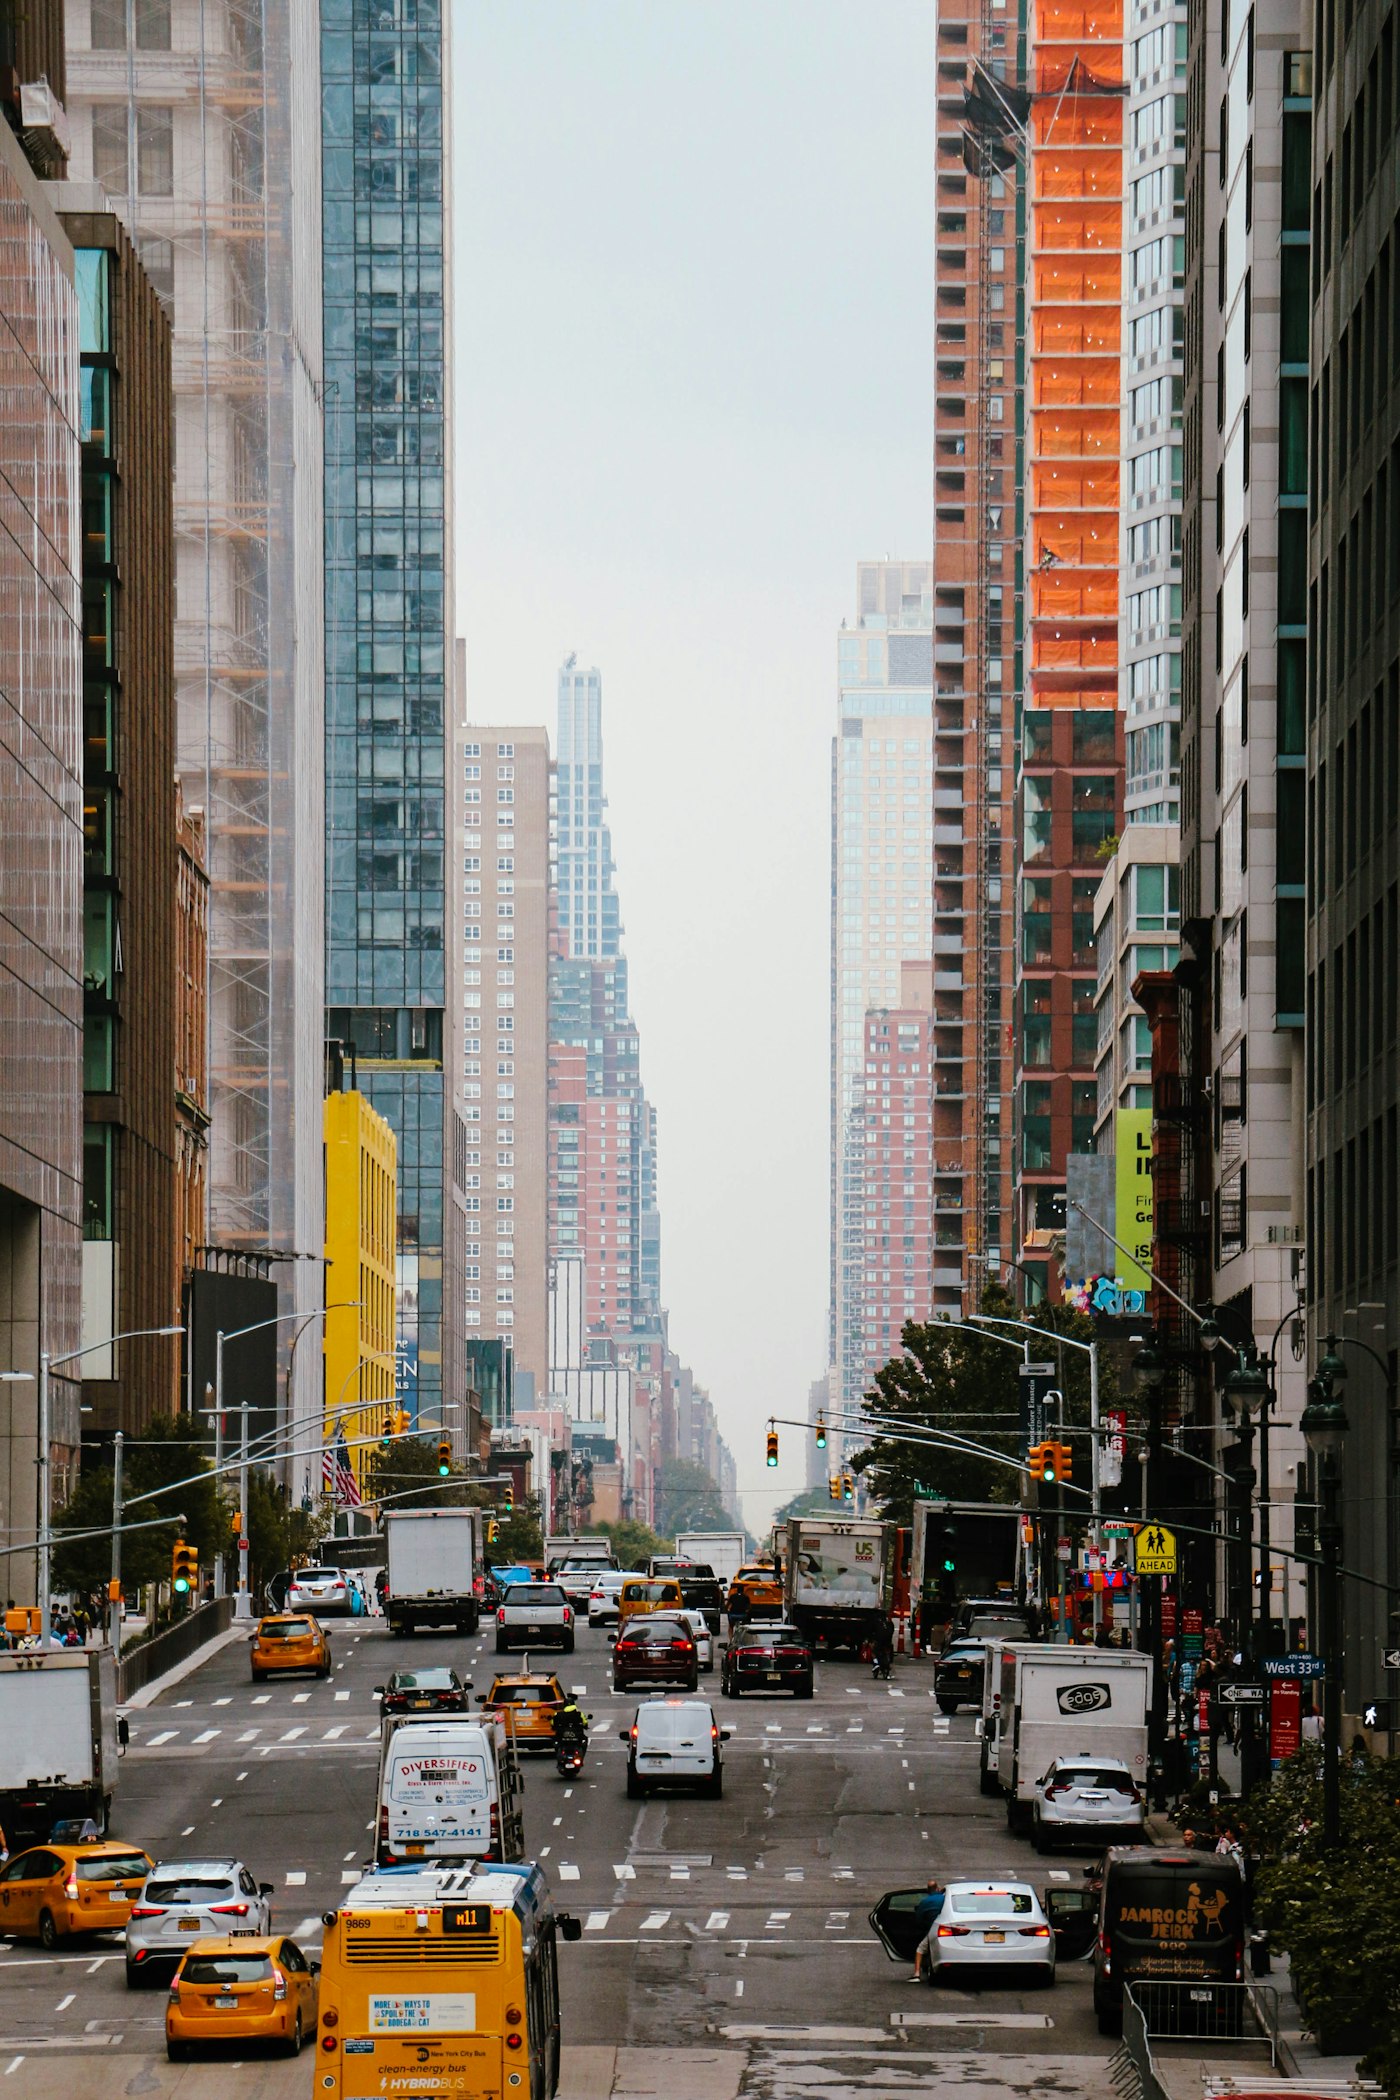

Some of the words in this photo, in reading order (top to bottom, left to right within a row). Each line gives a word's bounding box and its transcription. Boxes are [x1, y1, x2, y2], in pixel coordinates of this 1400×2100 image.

[856, 1541, 875, 1556] US.
[1139, 1562, 1173, 1570] AHEAD
[1265, 1661, 1296, 1674] West
[1298, 1661, 1320, 1675] 33rd
[1067, 1690, 1100, 1707] edge
[1227, 1690, 1244, 1698] ONE
[401, 1759, 477, 1776] DIVERSIFIED
[397, 1829, 420, 1837] 718
[424, 1828, 482, 1837] 547-4141
[1120, 1907, 1198, 1924] JAMROCK
[346, 1919, 371, 1929] 9869
[374, 2001, 391, 2009] MORE
[404, 2000, 421, 2008] WAYS
[422, 2000, 430, 2008] TO
[381, 2010, 398, 2018] SPOIL
[388, 2019, 412, 2027] BODEGA
[418, 2018, 430, 2026] CAT
[460, 2050, 473, 2058] City
[378, 2064, 445, 2074] clean-energy
[448, 2064, 467, 2073] bus
